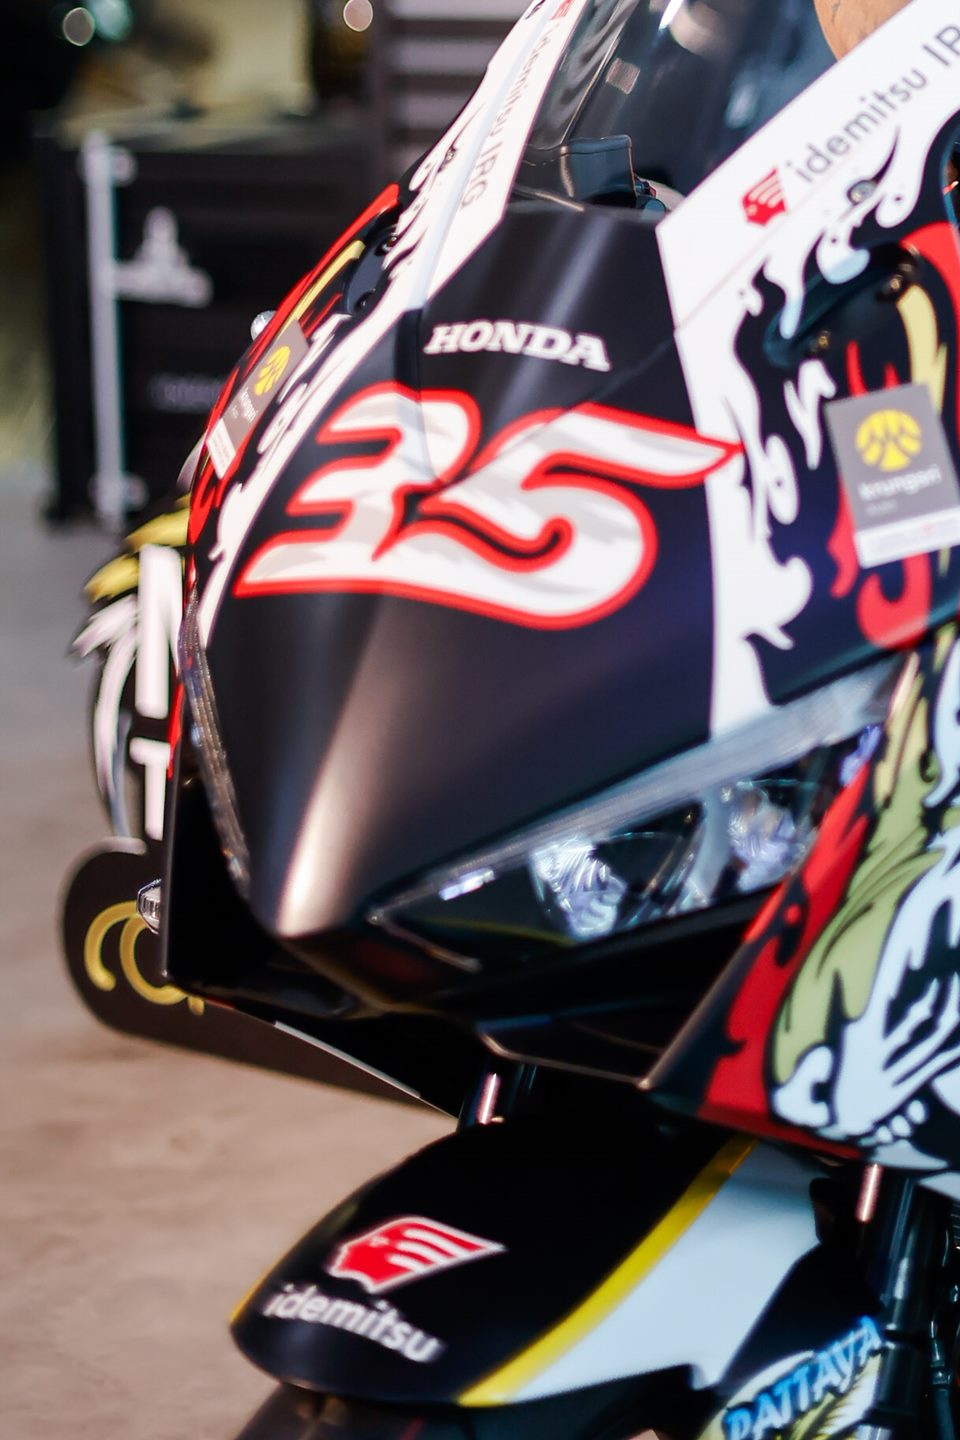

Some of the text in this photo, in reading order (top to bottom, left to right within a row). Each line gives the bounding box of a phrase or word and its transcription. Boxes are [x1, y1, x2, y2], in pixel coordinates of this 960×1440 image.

[786, 67, 929, 184] idemitsu
[460, 140, 504, 211] IRG
[422, 319, 613, 373] HONDA
[233, 380, 745, 631] 35
[262, 1282, 446, 1364] idemitsu
[723, 1316, 883, 1440] PATTAYA
